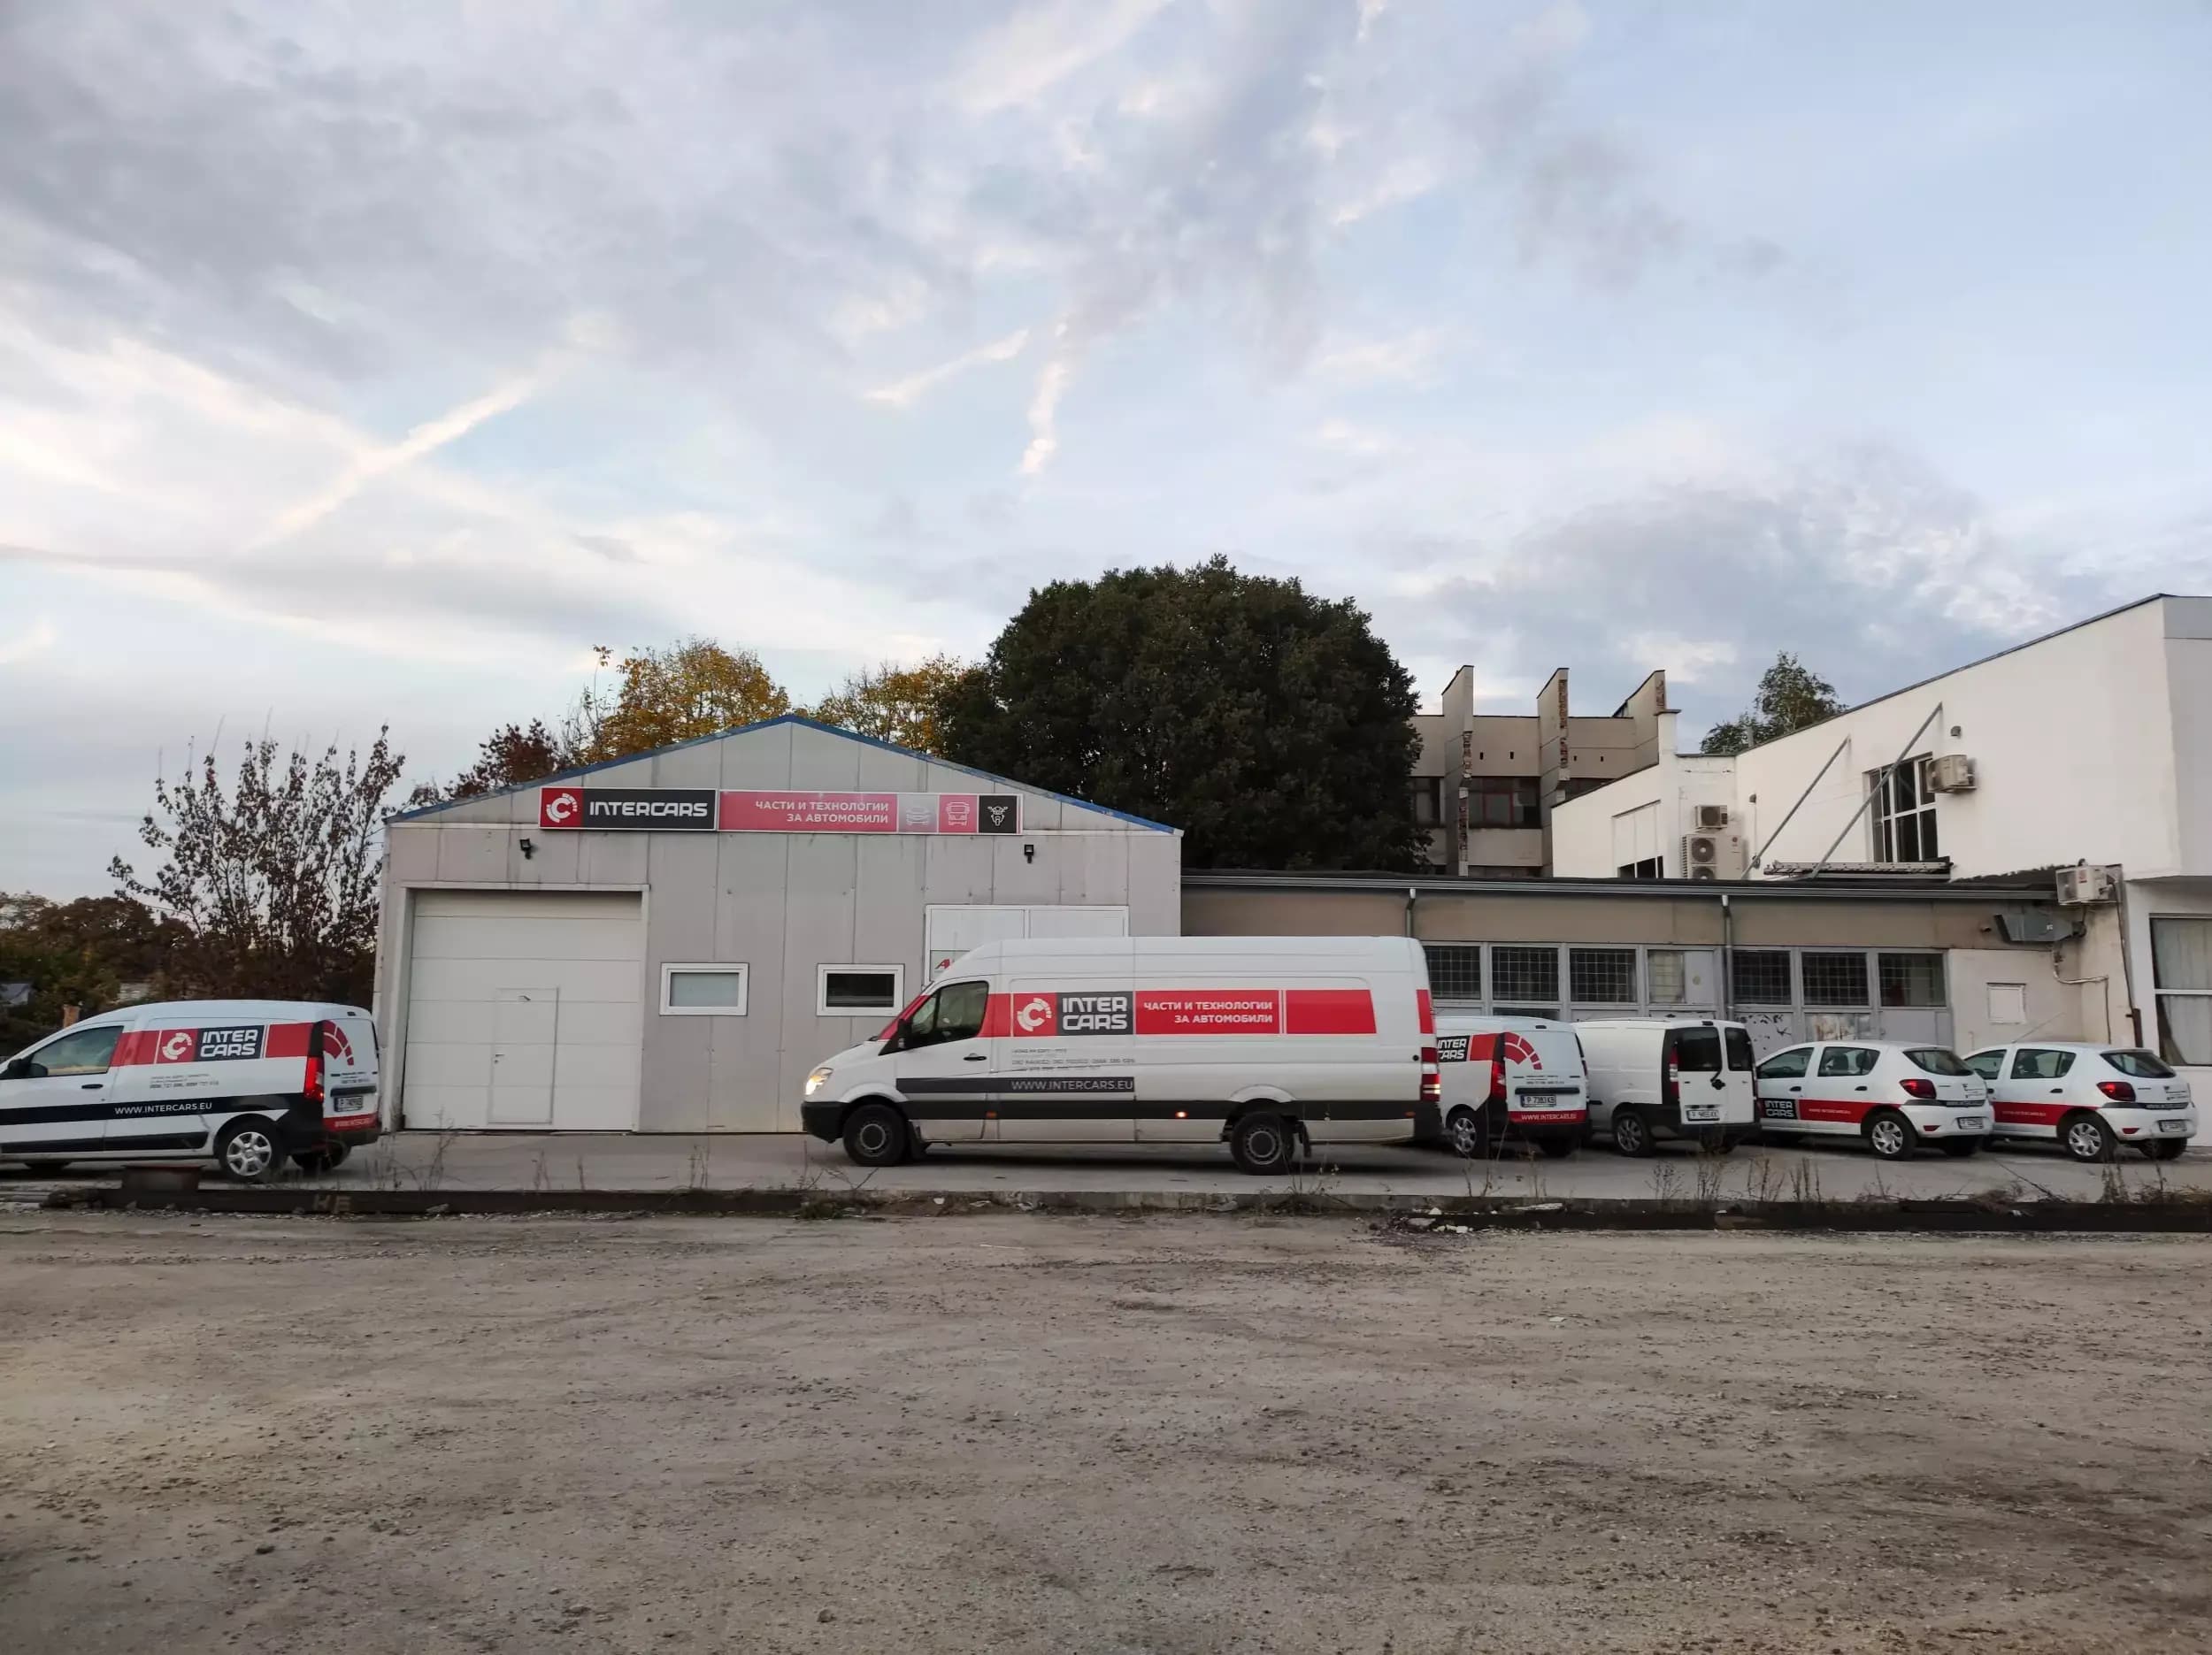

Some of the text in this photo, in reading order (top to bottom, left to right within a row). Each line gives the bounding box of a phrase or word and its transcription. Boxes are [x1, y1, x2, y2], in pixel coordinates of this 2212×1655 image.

[589, 801, 708, 817] INTERCARS
[755, 801, 889, 812] ЧАСТИ И ТЕХНОЛОГИИ
[787, 814, 888, 824] ЗА АВТОМОБИЛИ
[1062, 997, 1128, 1013] INTER
[1143, 1002, 1182, 1011] ЧАСТИ
[1195, 1001, 1273, 1010] ТЕХНОЛОГИИ
[1062, 1014, 1127, 1031] CARS
[1174, 1015, 1273, 1023] ЗА АВТОМОБИЛИ
[202, 1029, 258, 1044] INTER
[200, 1043, 256, 1057] CARS
[1010, 1080, 1133, 1091] WWW.INTERCARS.EU
[114, 1102, 212, 1115] WWW.INTERCARS.EU
